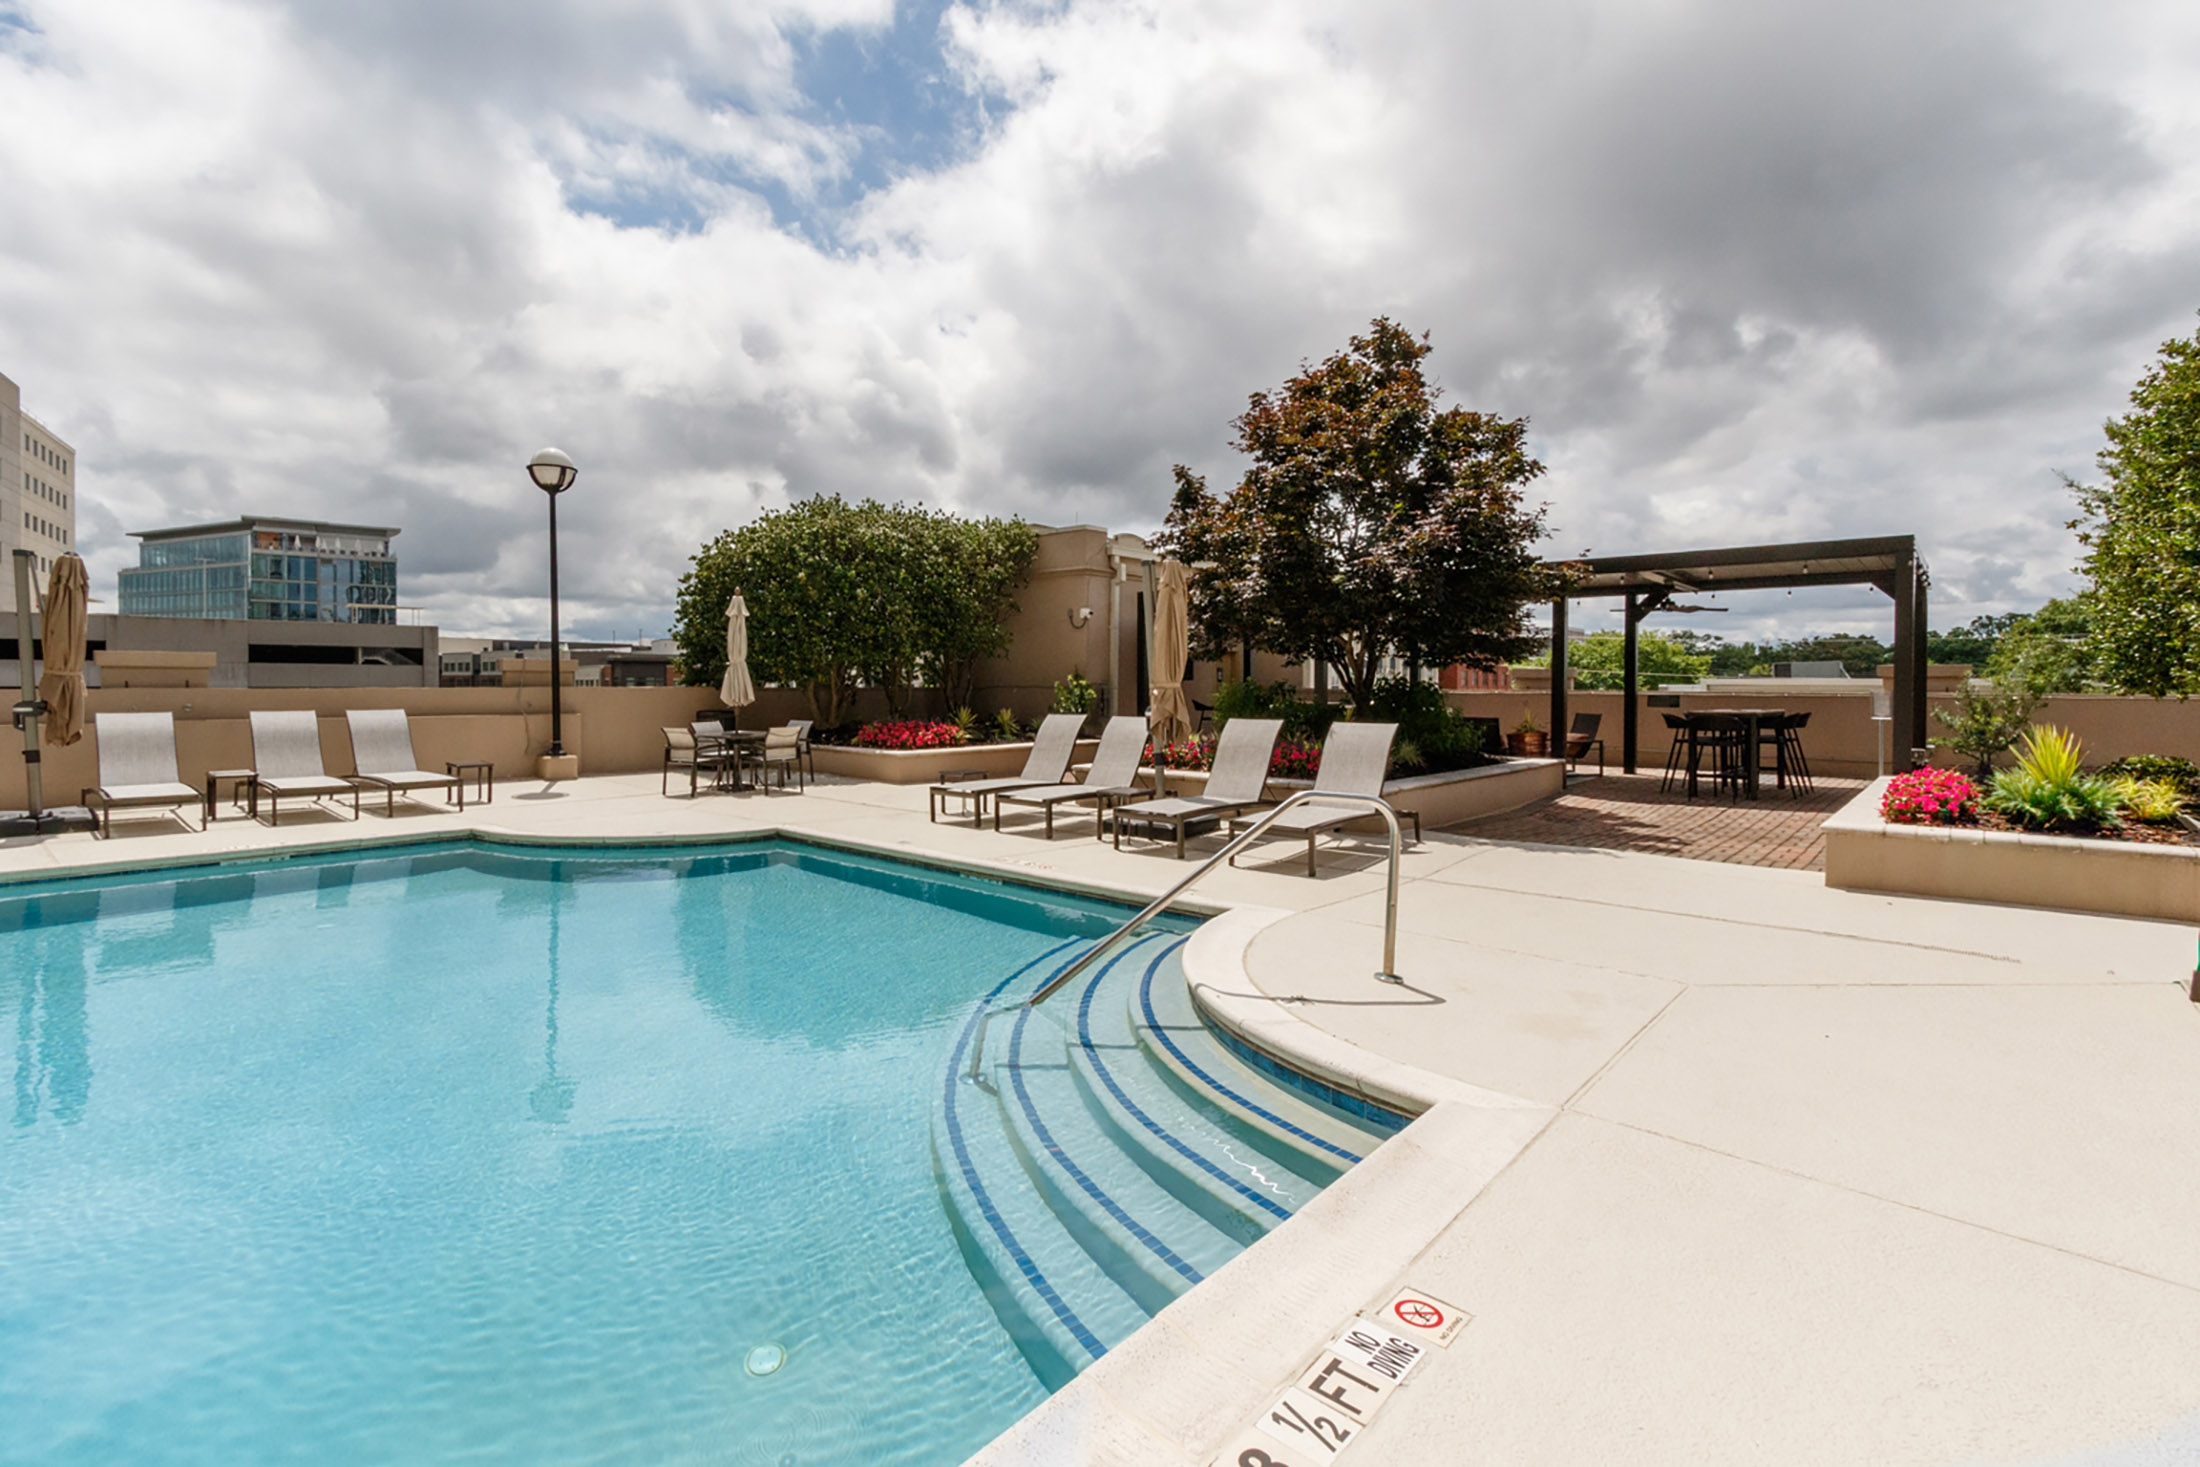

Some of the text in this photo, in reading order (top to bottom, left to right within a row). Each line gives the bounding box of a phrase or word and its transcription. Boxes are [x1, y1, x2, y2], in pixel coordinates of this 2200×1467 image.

[1344, 1331, 1381, 1355] NO
[1366, 1338, 1420, 1380] DIVING
[1308, 1357, 1380, 1416] FT
